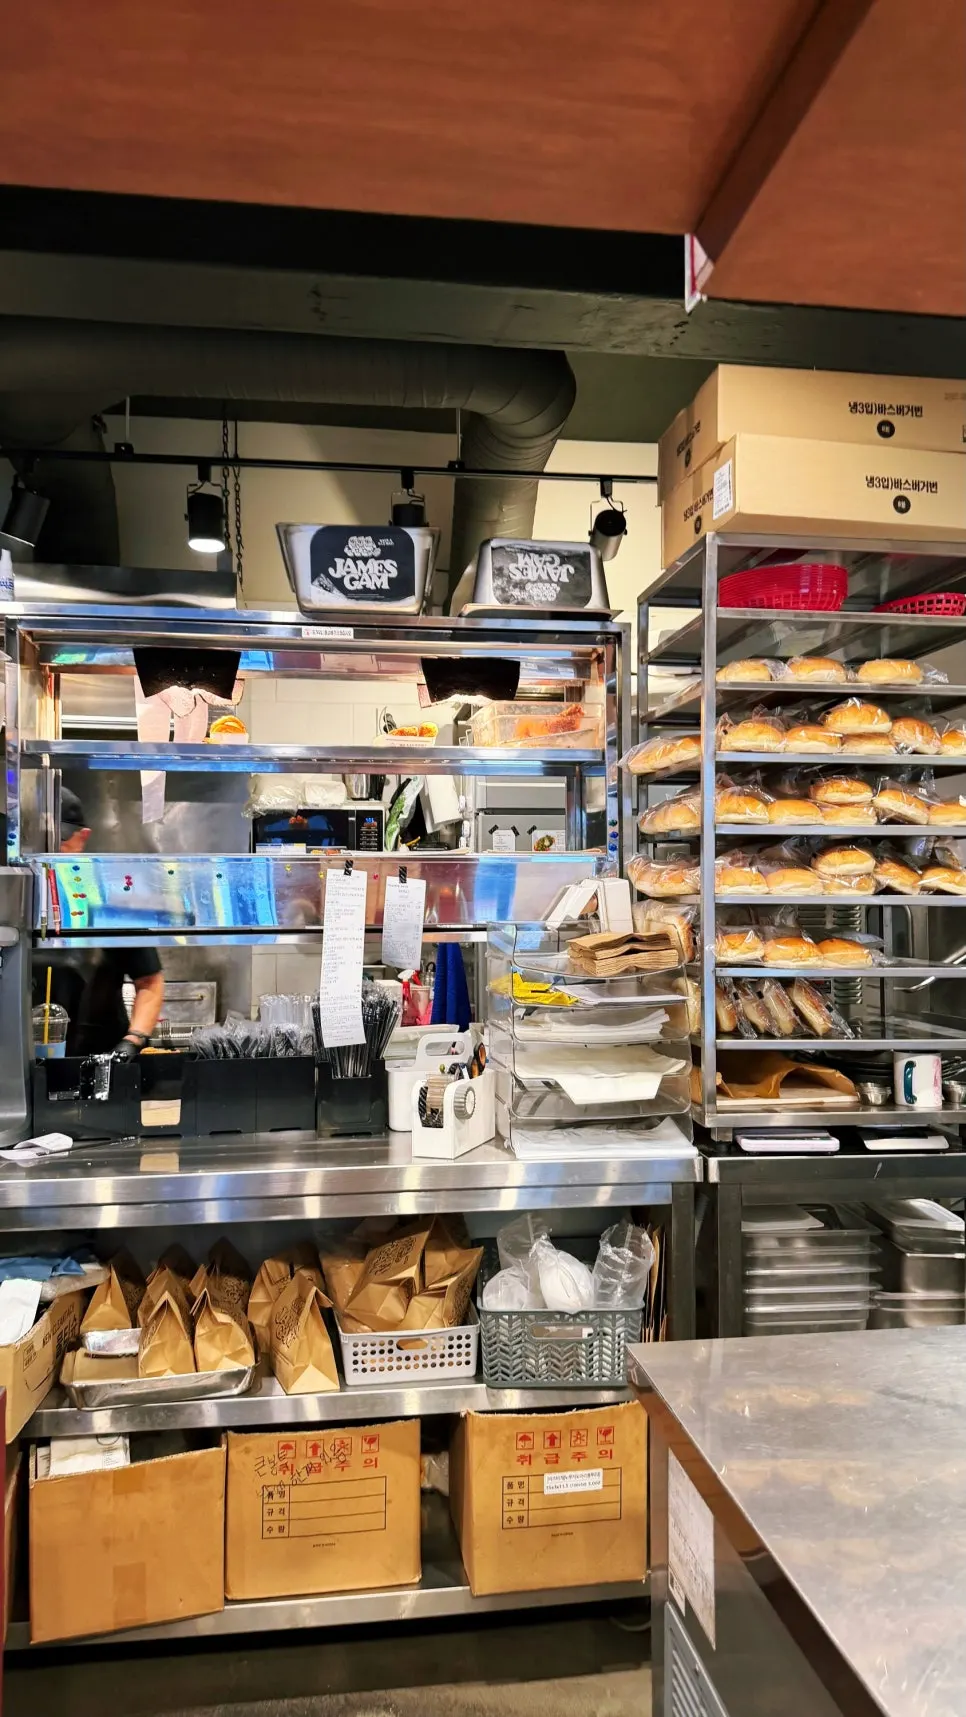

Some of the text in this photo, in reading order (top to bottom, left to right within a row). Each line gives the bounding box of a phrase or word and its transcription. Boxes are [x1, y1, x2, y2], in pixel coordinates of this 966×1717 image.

[328, 557, 398, 579] JAMES
[516, 553, 561, 567] GAM
[343, 573, 390, 591] GAM
[508, 563, 575, 583] JAMES
[516, 1449, 613, 1465] 취급주의
